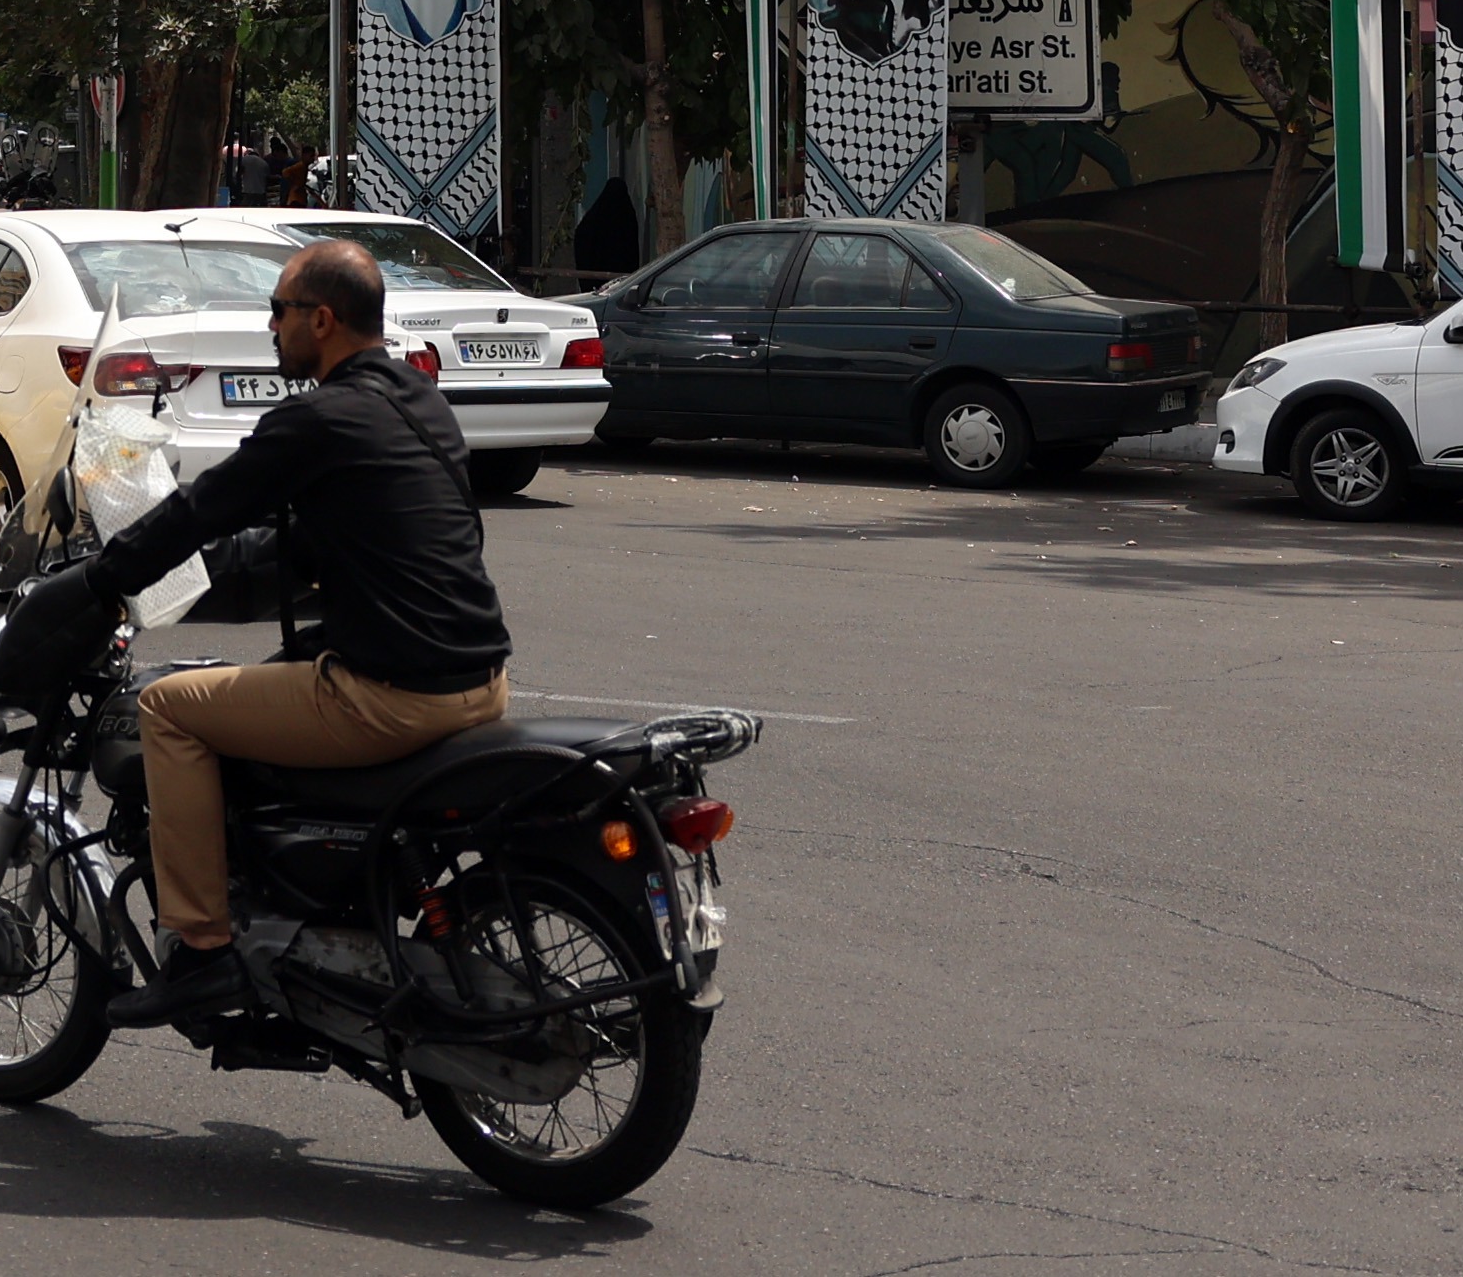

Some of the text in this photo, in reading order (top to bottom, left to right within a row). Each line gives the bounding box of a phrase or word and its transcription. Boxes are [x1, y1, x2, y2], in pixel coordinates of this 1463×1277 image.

[990, 35, 1035, 59] Asr
[1042, 34, 1076, 59] St.
[1018, 69, 1053, 94] St.
[236, 378, 259, 398] ۴۴
[266, 380, 280, 397] د
